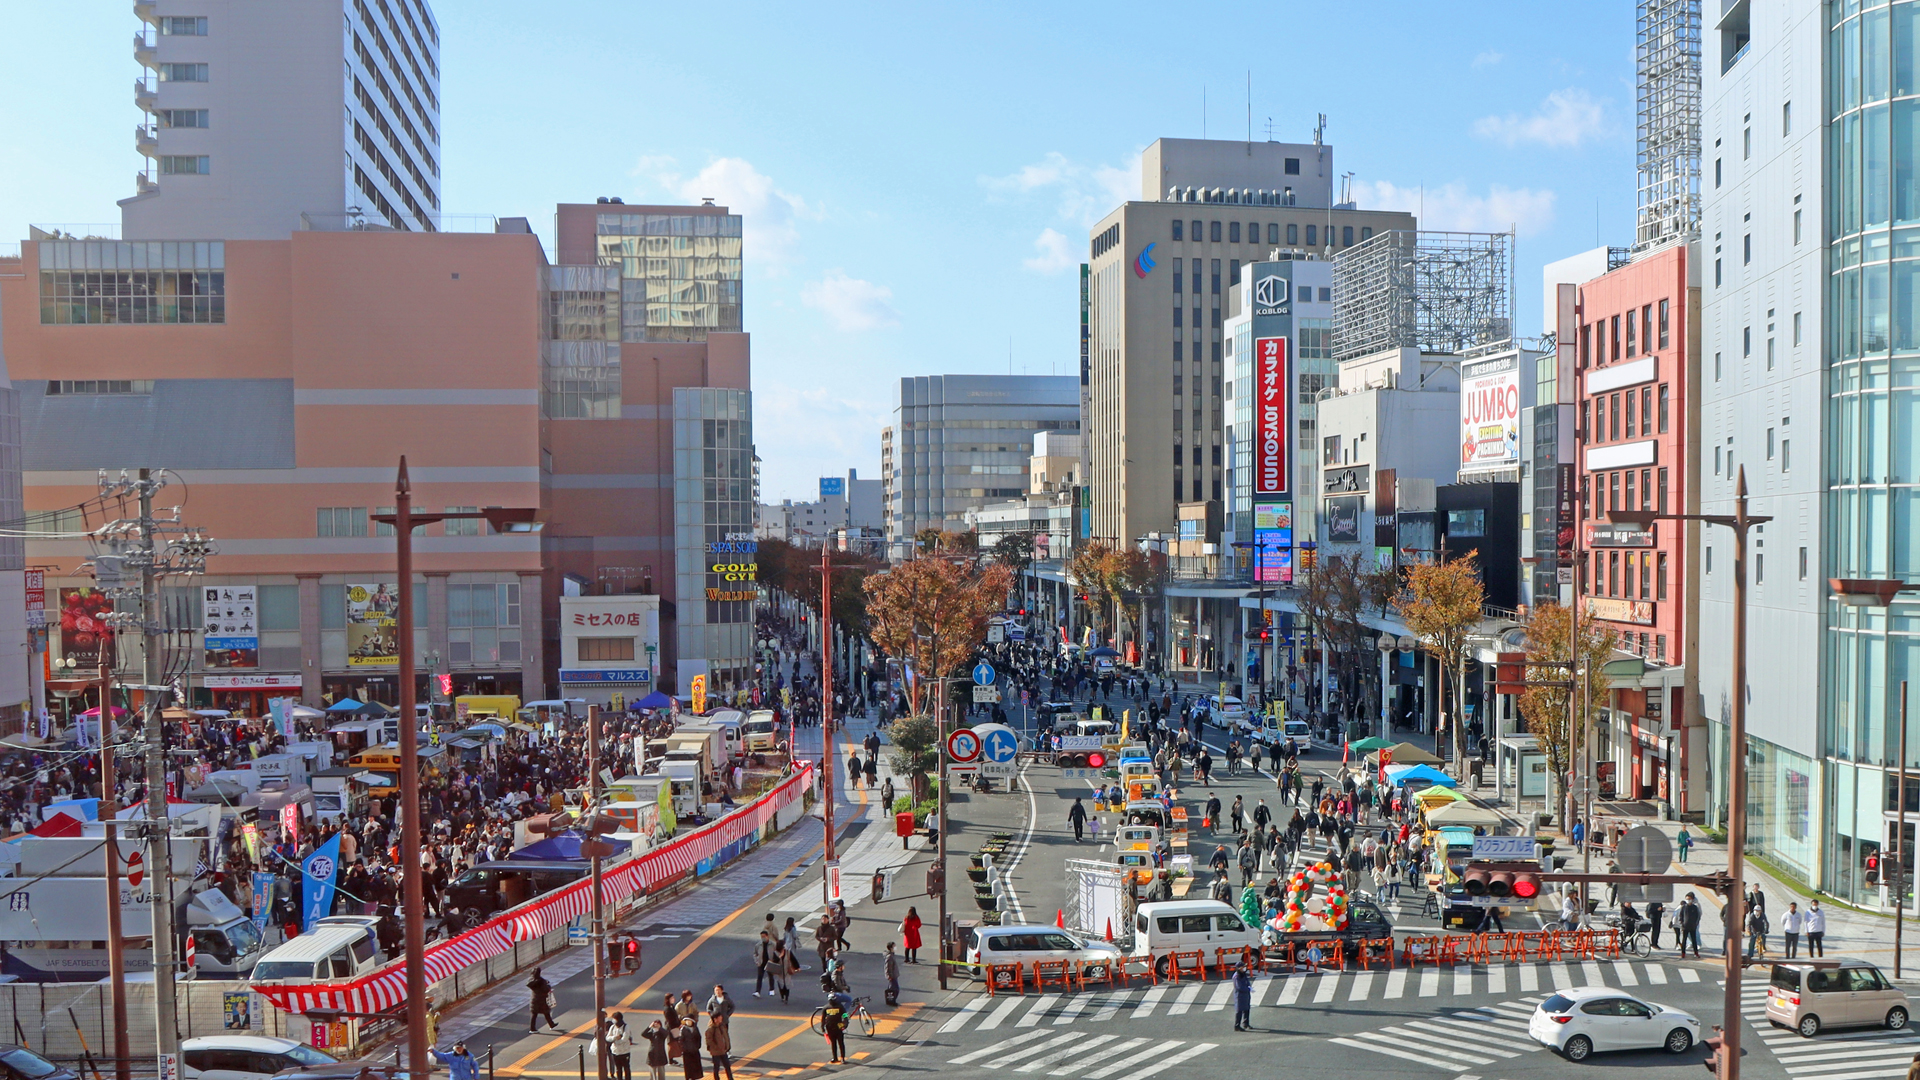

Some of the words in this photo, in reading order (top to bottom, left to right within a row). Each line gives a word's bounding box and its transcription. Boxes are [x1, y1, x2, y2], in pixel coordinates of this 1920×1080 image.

[1264, 341, 1278, 401] カラオケ
[1464, 384, 1518, 425] JUMBO
[1479, 425, 1503, 438] EXCITING
[1264, 405, 1278, 490] JOYSOUND
[710, 542, 733, 554] SPA
[26, 571, 44, 589] 貸店舗
[725, 573, 755, 581] GYM
[573, 612, 640, 626] ミセスの店
[564, 672, 602, 680] ミセスの店
[607, 671, 645, 680] マルスズ
[1064, 738, 1099, 746] スクランブル式
[1066, 769, 1098, 777] 時差式
[1476, 839, 1533, 852] スクランブル式
[167, 1057, 176, 1080] かに
